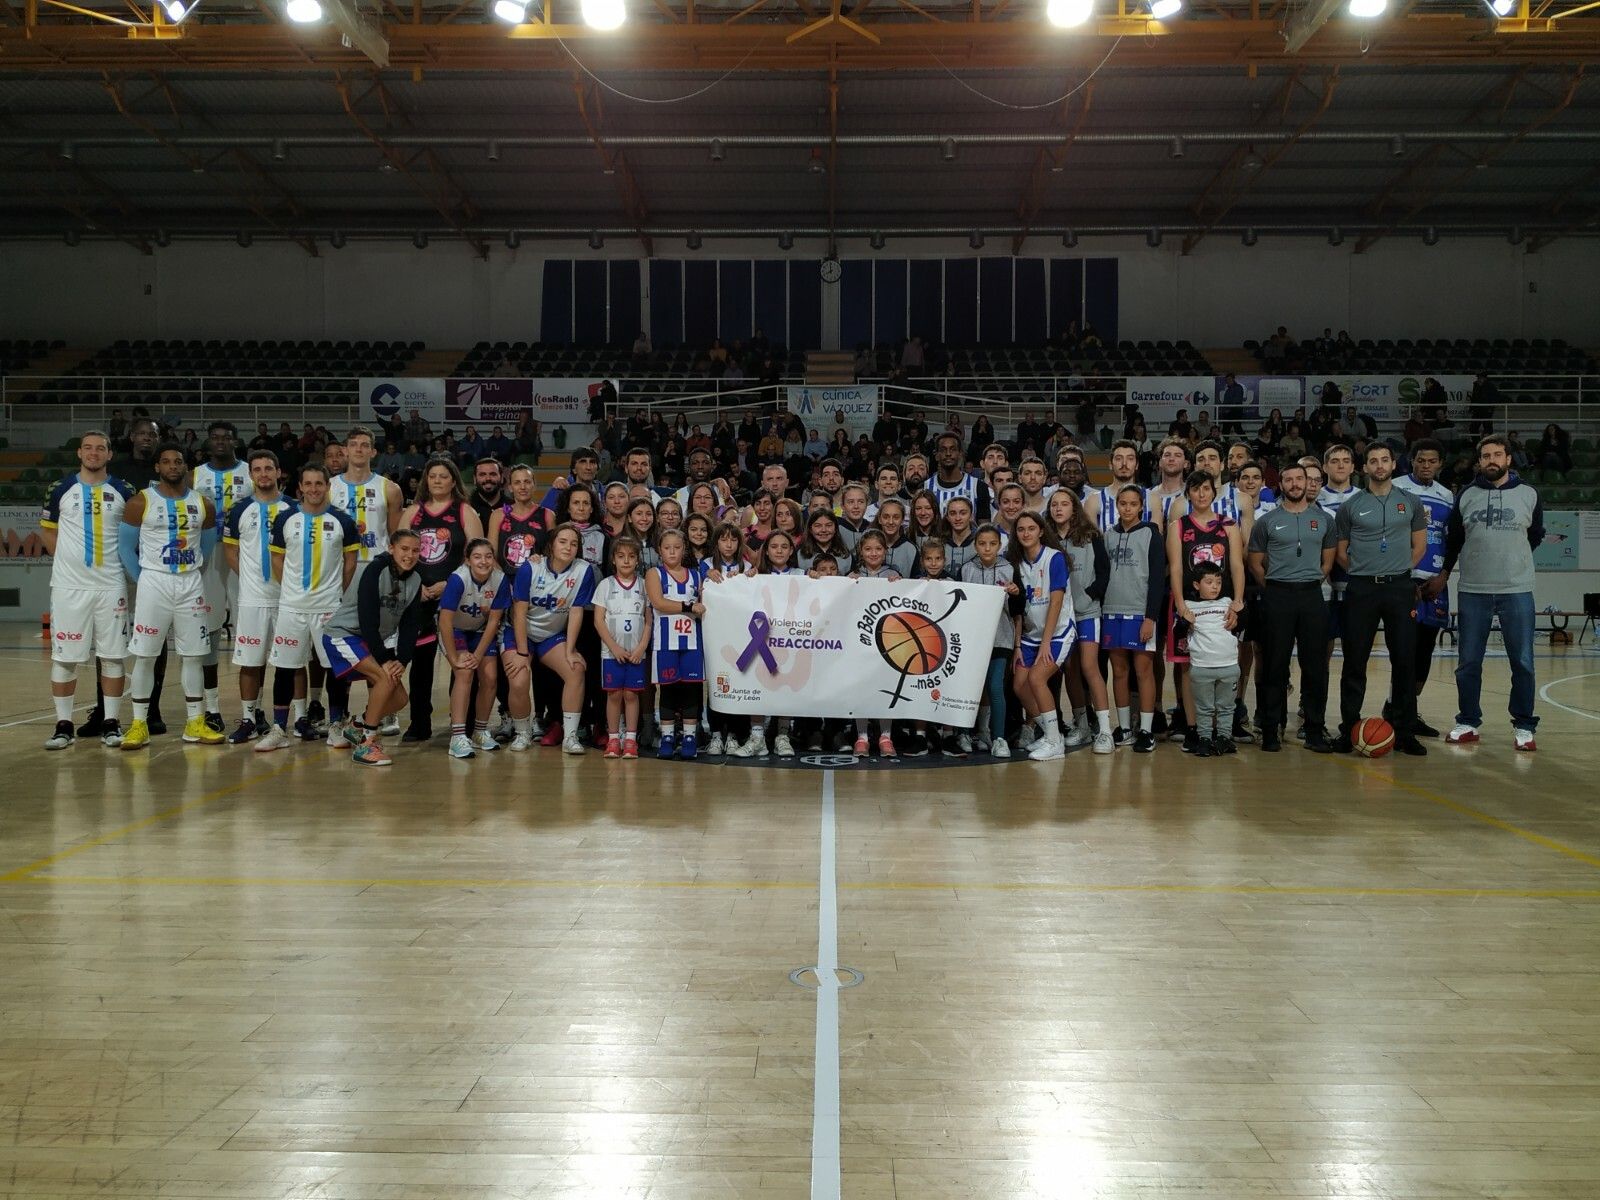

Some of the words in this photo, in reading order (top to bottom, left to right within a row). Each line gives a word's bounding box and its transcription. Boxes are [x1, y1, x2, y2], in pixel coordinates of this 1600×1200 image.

[404, 392, 427, 400] COPE
[541, 395, 579, 403] esRadio
[1131, 391, 1184, 401] Carrefour
[494, 410, 520, 420] reina
[214, 485, 234, 501] 34
[84, 501, 101, 516] 33
[346, 496, 367, 513] 44
[168, 514, 190, 531] 32
[308, 530, 316, 545] 5
[566, 578, 576, 589] 16
[624, 619, 632, 632] 3
[674, 618, 692, 634] 42
[768, 617, 813, 628] Violencia
[143, 624, 159, 635] ice
[788, 627, 812, 636] Cero
[66, 630, 83, 641] ice
[246, 634, 261, 646] ice
[859, 633, 872, 646] en
[283, 636, 299, 647] ice
[768, 637, 843, 650] REACCIONA
[713, 692, 736, 700] Castilla
